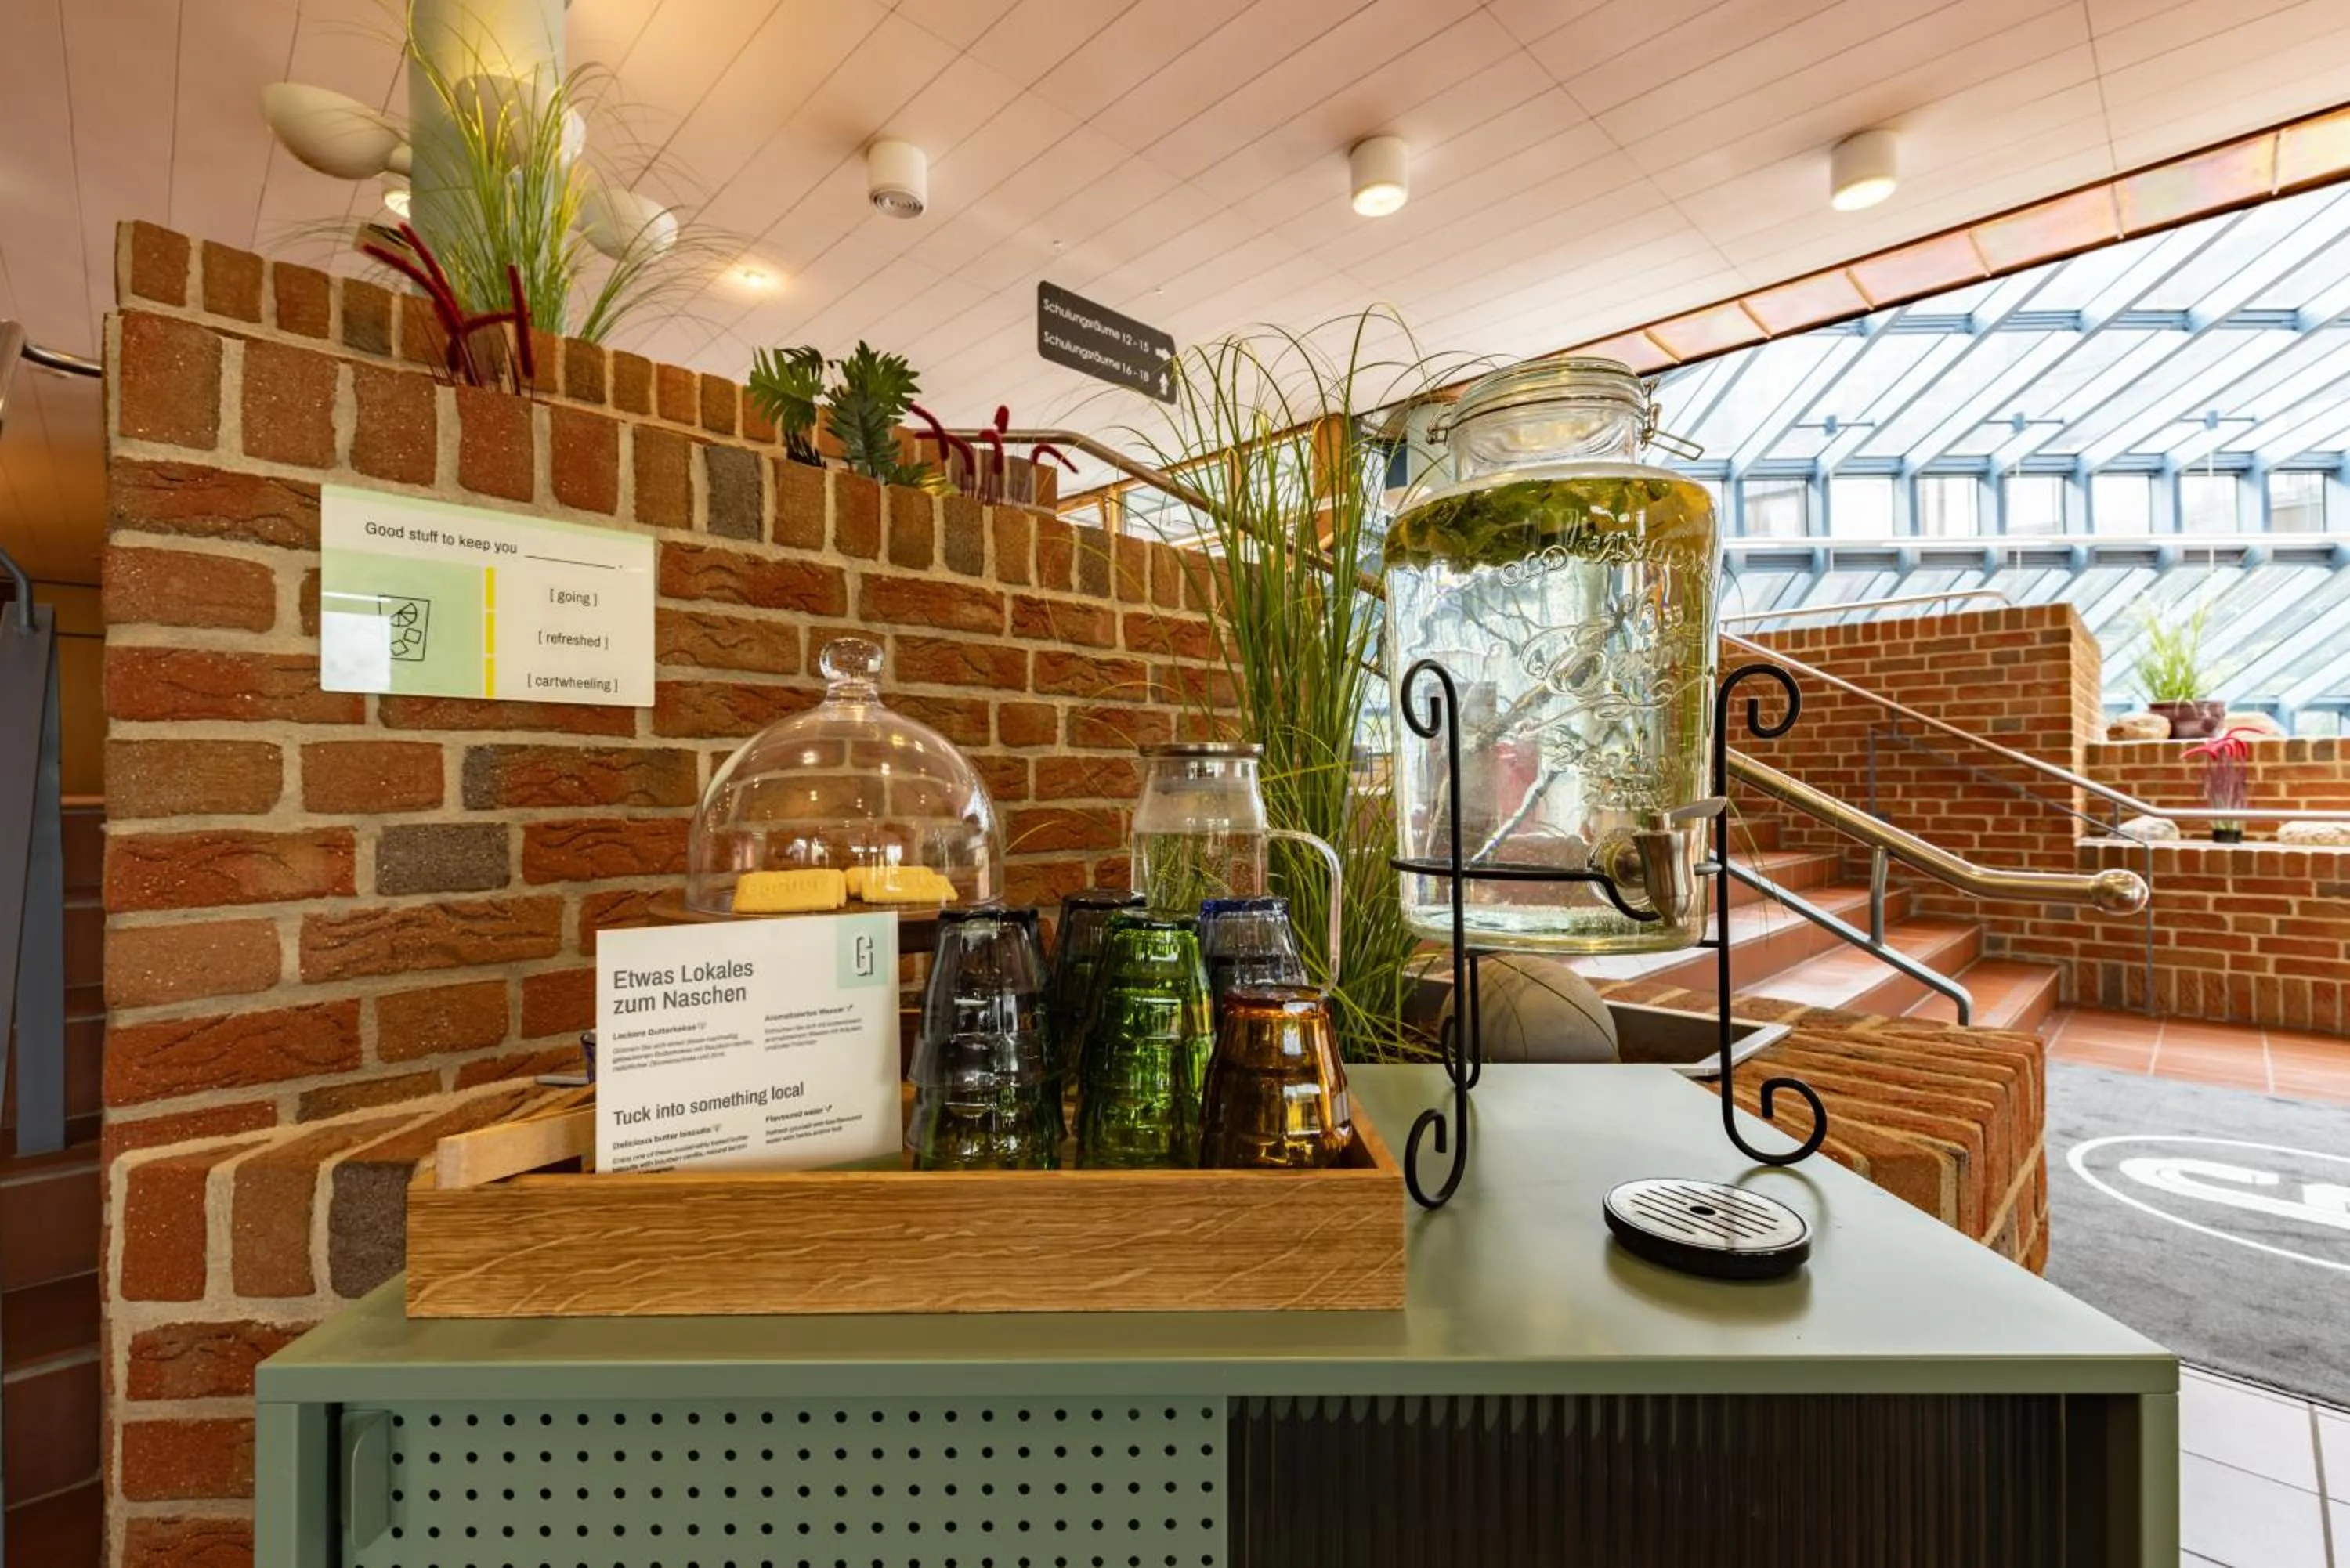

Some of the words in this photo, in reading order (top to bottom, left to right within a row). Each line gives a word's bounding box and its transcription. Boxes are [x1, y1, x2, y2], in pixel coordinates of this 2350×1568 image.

[1043, 298, 1121, 341] Schulungsräume
[1122, 333, 1133, 346] 12
[1043, 331, 1121, 370] Schulungsräume
[1122, 363, 1133, 377] 16
[1139, 370, 1150, 383] 18
[364, 521, 405, 540] Good
[408, 526, 439, 543] stuff
[442, 531, 455, 547] to
[457, 533, 491, 553] keep
[494, 540, 519, 556] you
[557, 589, 591, 607] going
[545, 631, 602, 648] refreshed
[534, 674, 611, 693] cartwheeling
[613, 969, 675, 990] Etwas
[681, 959, 755, 984] Lokales
[613, 994, 656, 1016] zum
[663, 985, 747, 1010] Naschen
[613, 1106, 652, 1126] Tuck
[656, 1102, 685, 1120] into
[689, 1088, 768, 1115] something
[771, 1081, 804, 1101] local
